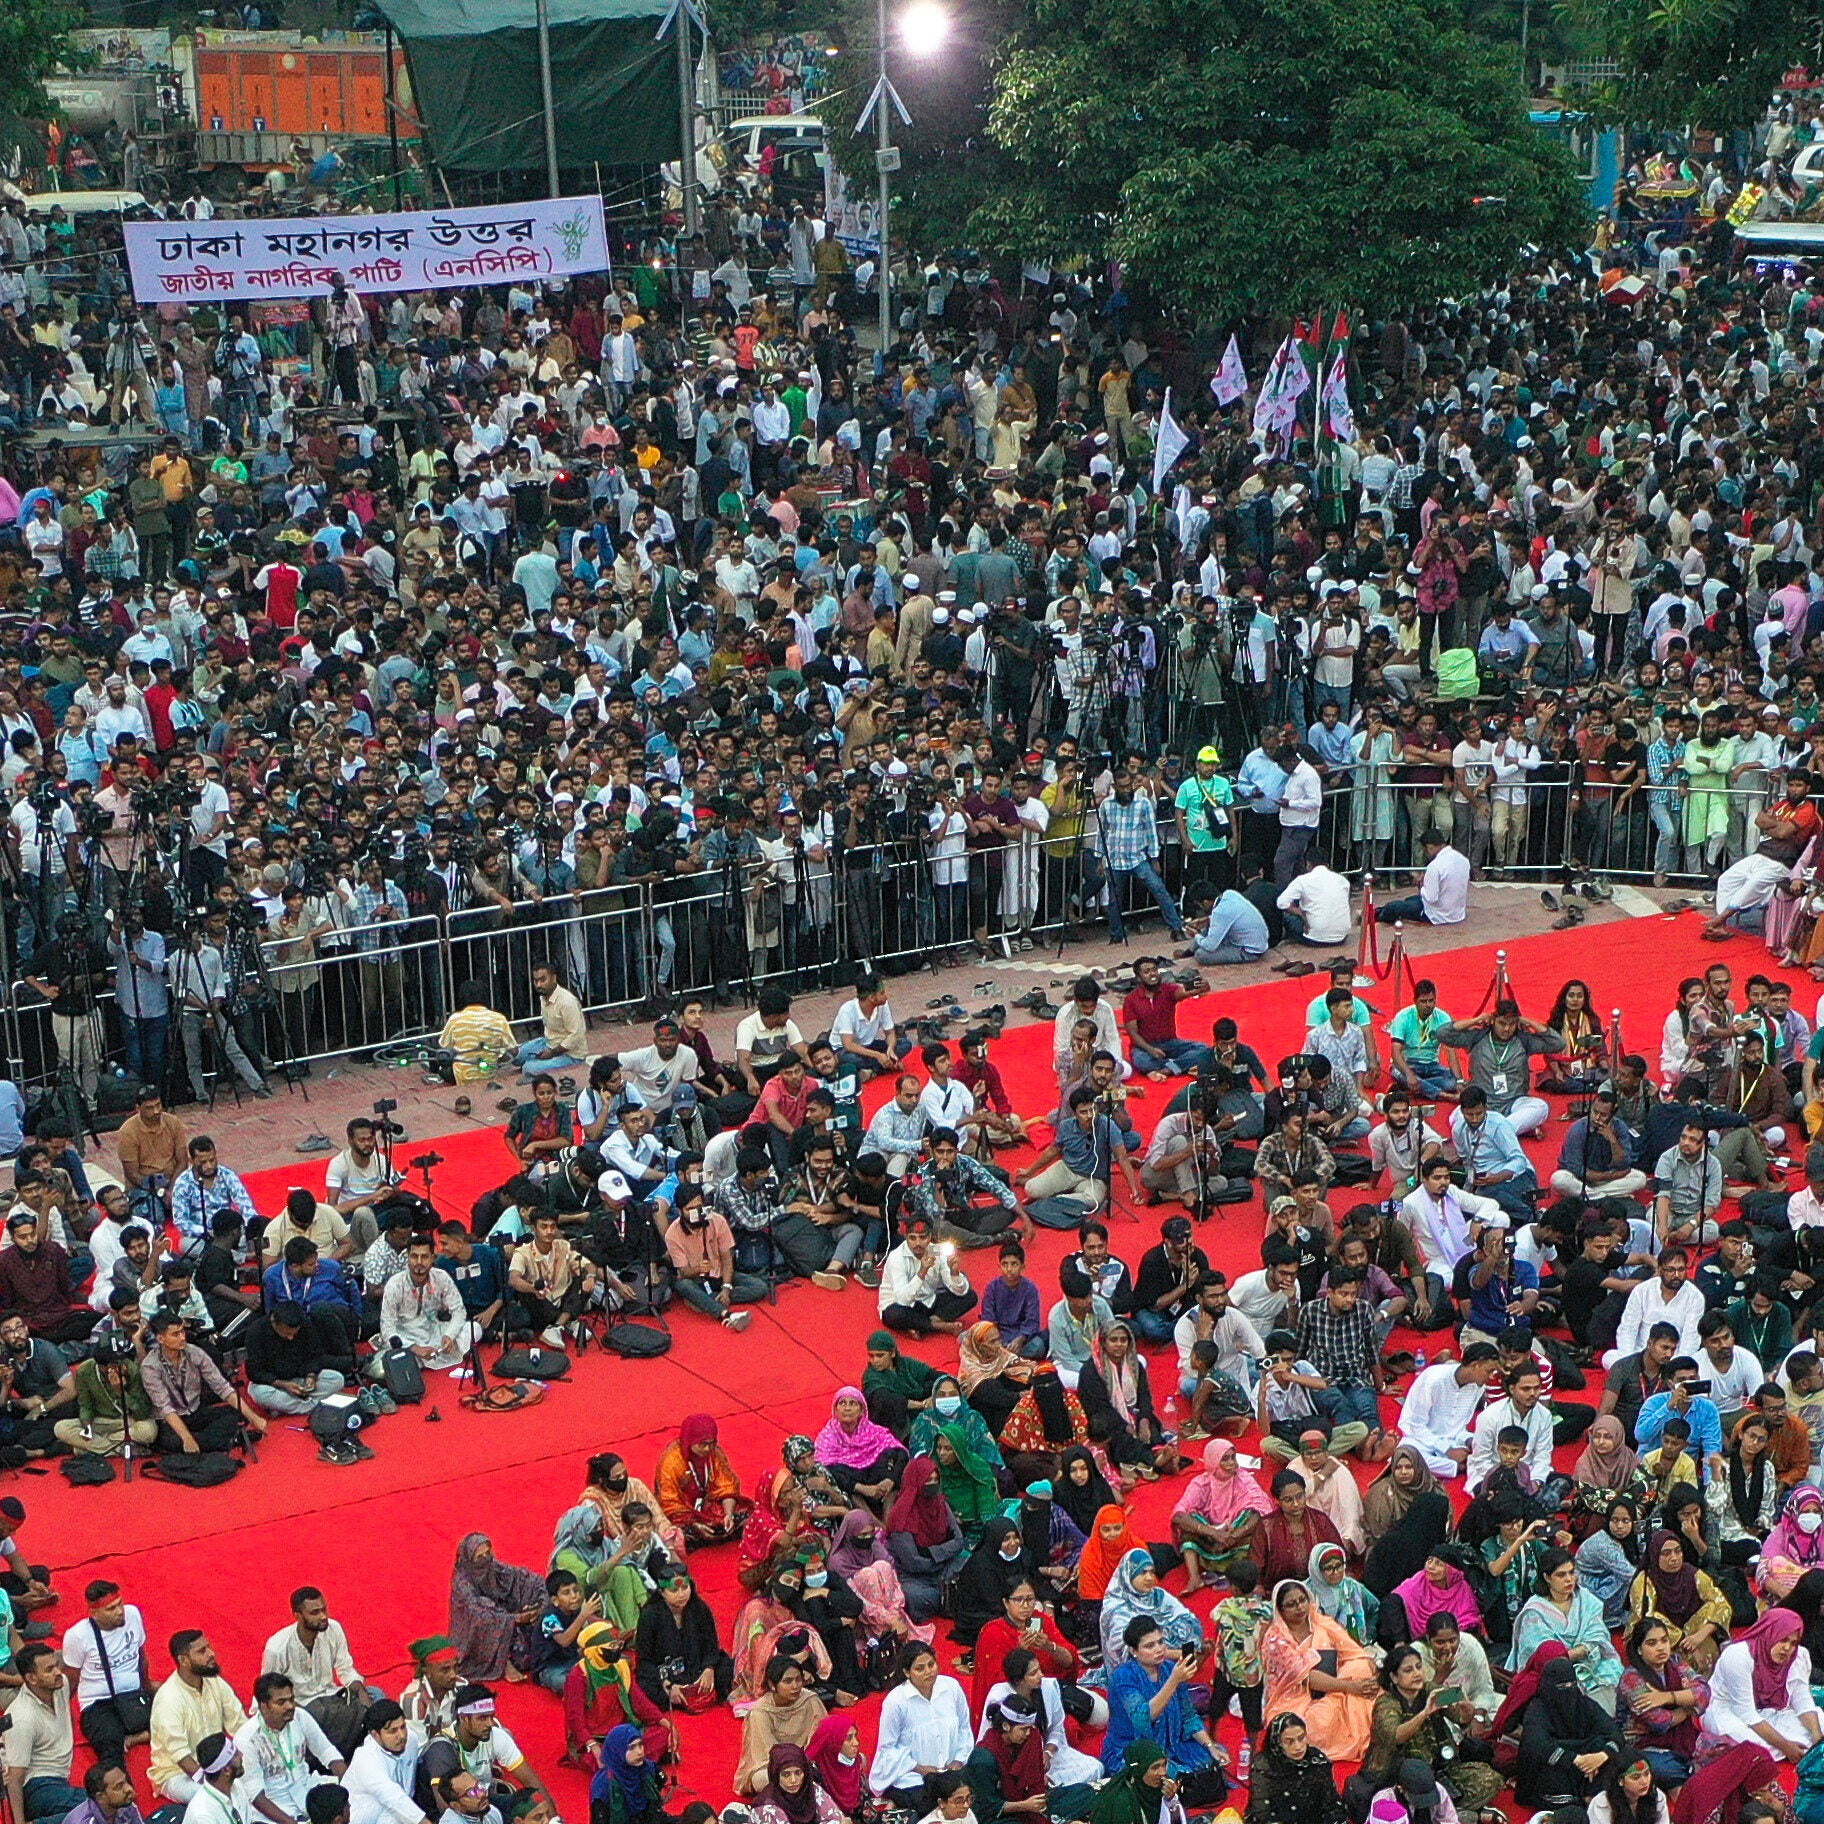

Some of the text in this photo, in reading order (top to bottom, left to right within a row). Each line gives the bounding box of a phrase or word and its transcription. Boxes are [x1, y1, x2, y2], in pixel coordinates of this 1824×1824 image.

[159, 216, 537, 260] ঢাকা মহানগর উত্তর
[160, 246, 553, 294] জাতীয় নাগরিক পার্টি (এনসিপি)
